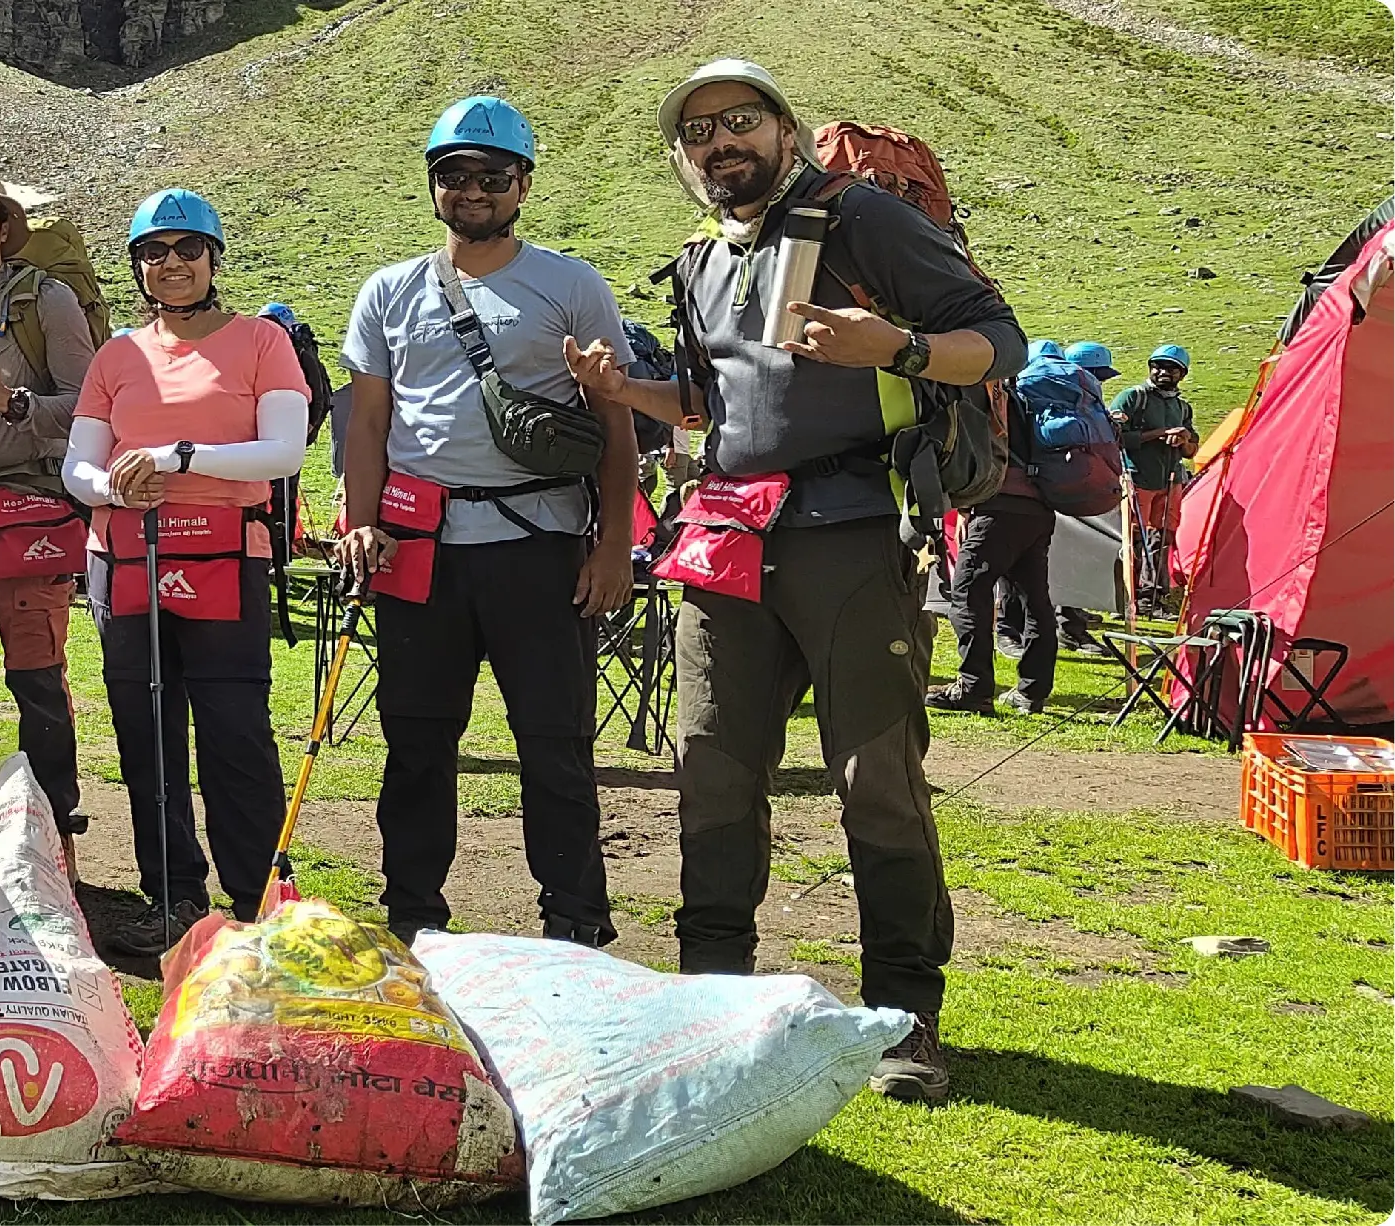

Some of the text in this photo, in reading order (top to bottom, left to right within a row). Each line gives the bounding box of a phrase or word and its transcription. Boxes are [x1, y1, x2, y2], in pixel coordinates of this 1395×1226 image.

[168, 516, 208, 528] Himala
[1316, 804, 1327, 856] LFC
[3, 972, 73, 996] ELBOW
[6, 1004, 89, 1025] ITALIAN QUALITY
